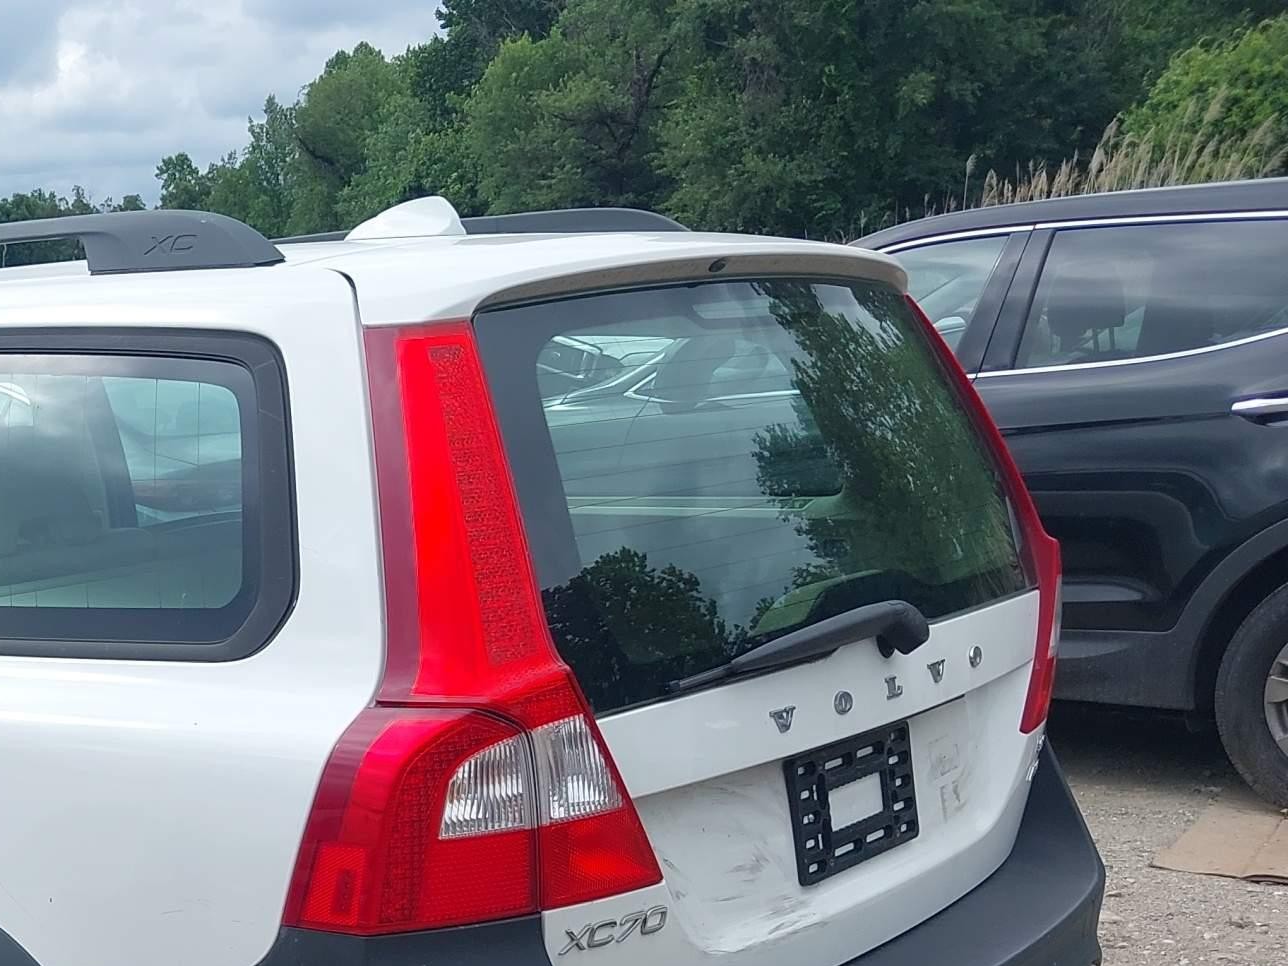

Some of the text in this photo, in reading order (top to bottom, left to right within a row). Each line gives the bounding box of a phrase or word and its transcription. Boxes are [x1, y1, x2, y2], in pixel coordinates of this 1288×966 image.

[144, 234, 198, 255] XC
[769, 645, 983, 734] VOLVO
[558, 904, 668, 956] XC70
